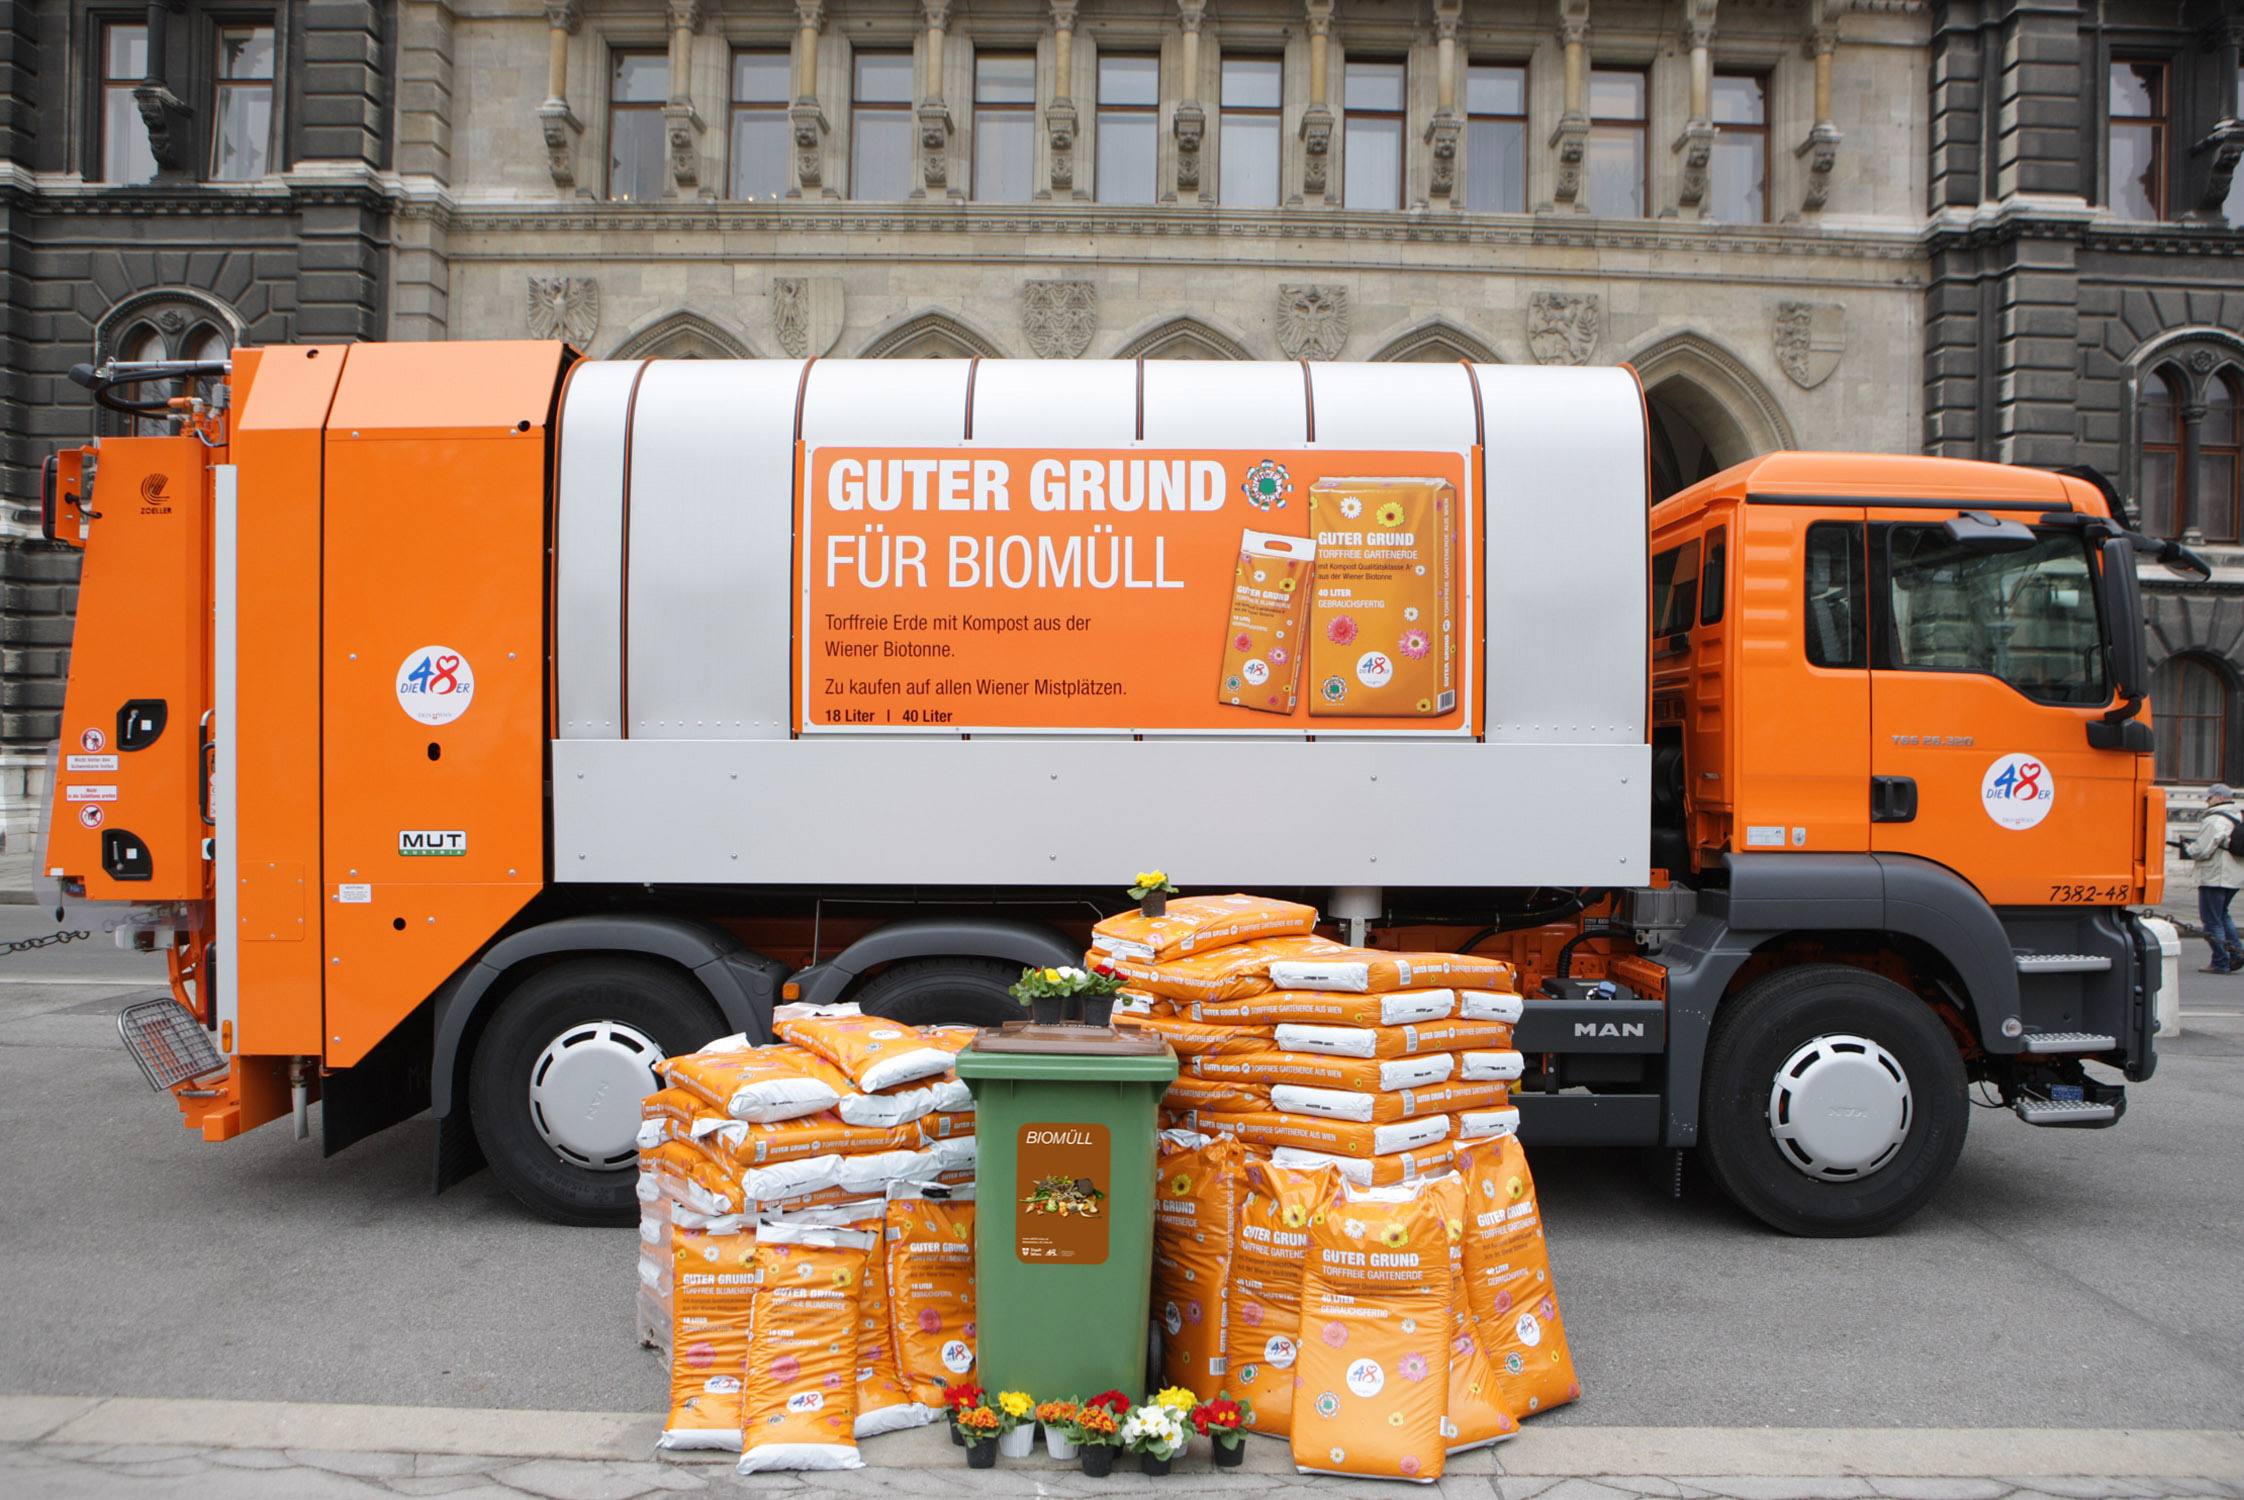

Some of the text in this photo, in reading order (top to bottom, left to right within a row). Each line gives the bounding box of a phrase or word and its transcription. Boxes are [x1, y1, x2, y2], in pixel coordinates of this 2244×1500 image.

[827, 458, 1226, 512] GUTER GRUND
[1318, 532, 1414, 546] GUTER GRUND
[826, 524, 1185, 589] FÜR BIOMÜLL
[1318, 549, 1418, 559] TORFFREIE GARTENERDE
[1330, 589, 1352, 597] LITER
[825, 614, 1091, 636] Torffreie Erde mit Kompost aus der
[825, 640, 955, 658] Wiener Biotonne.
[825, 678, 1127, 700] Zu kaufen auf allen Wiener Mistplätzen.
[825, 709, 953, 723] 18 Liter 40 Liter
[1891, 735, 1919, 745] TGS
[403, 834, 462, 848] MUT
[2049, 884, 2129, 902] 7382-48
[1574, 1023, 1644, 1037] MAN
[1026, 1129, 1093, 1145] BIOMÜLL
[1163, 1200, 1195, 1215] GRUND
[1243, 1225, 1307, 1246] GUTER GRUN
[1322, 1248, 1366, 1266] GUTER
[1370, 1253, 1420, 1267] GRUND
[683, 1273, 755, 1285] GUTER GRUND
[1322, 1265, 1423, 1280] TORFFREIE GARTENERDE
